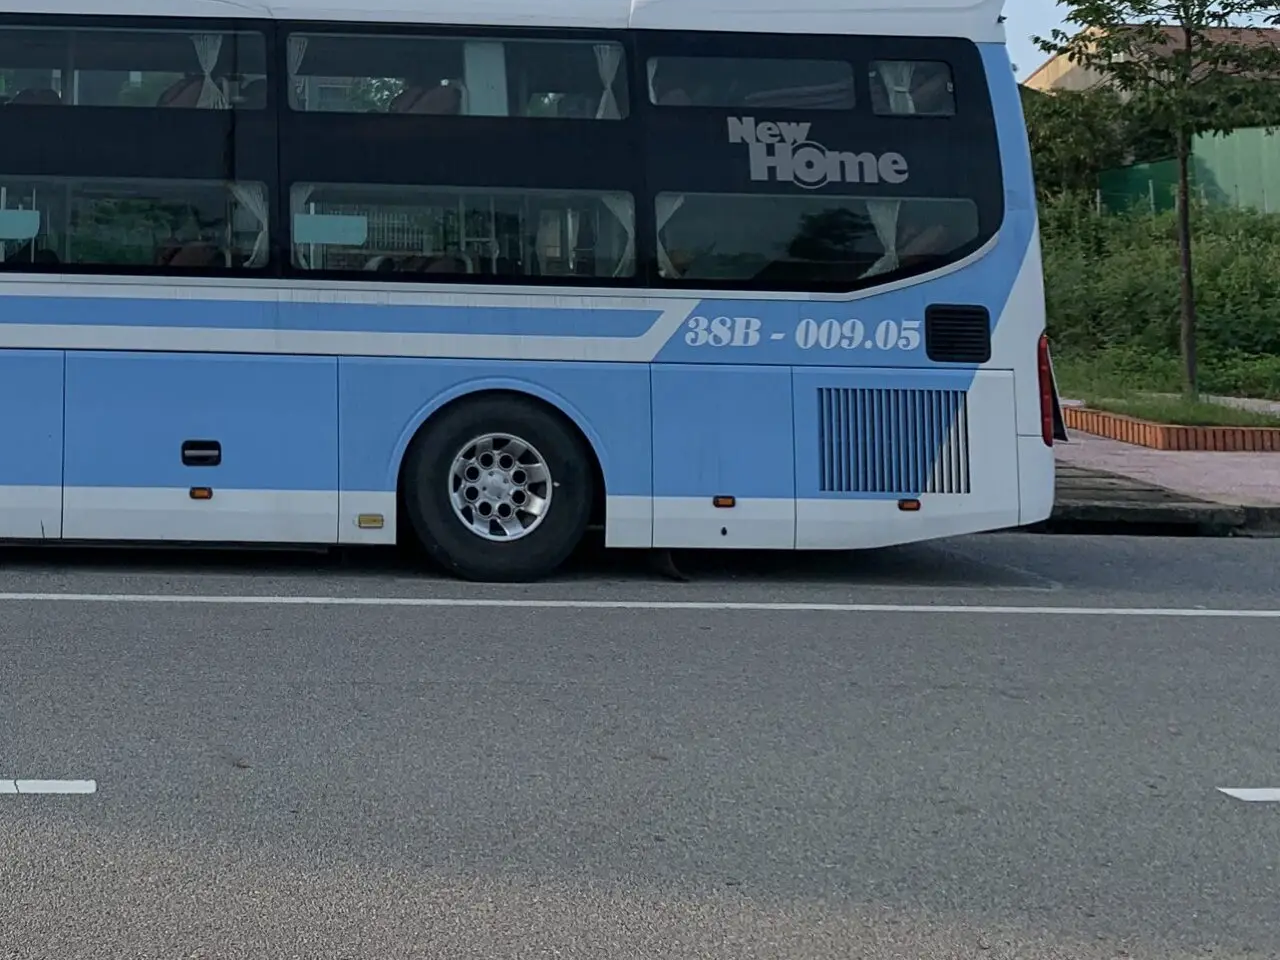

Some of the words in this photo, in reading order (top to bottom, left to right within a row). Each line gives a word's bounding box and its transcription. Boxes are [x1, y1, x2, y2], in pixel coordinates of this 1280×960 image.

[727, 116, 812, 144] New
[748, 140, 909, 189] Home
[684, 316, 761, 347] 38B
[795, 318, 921, 350] 009.05
